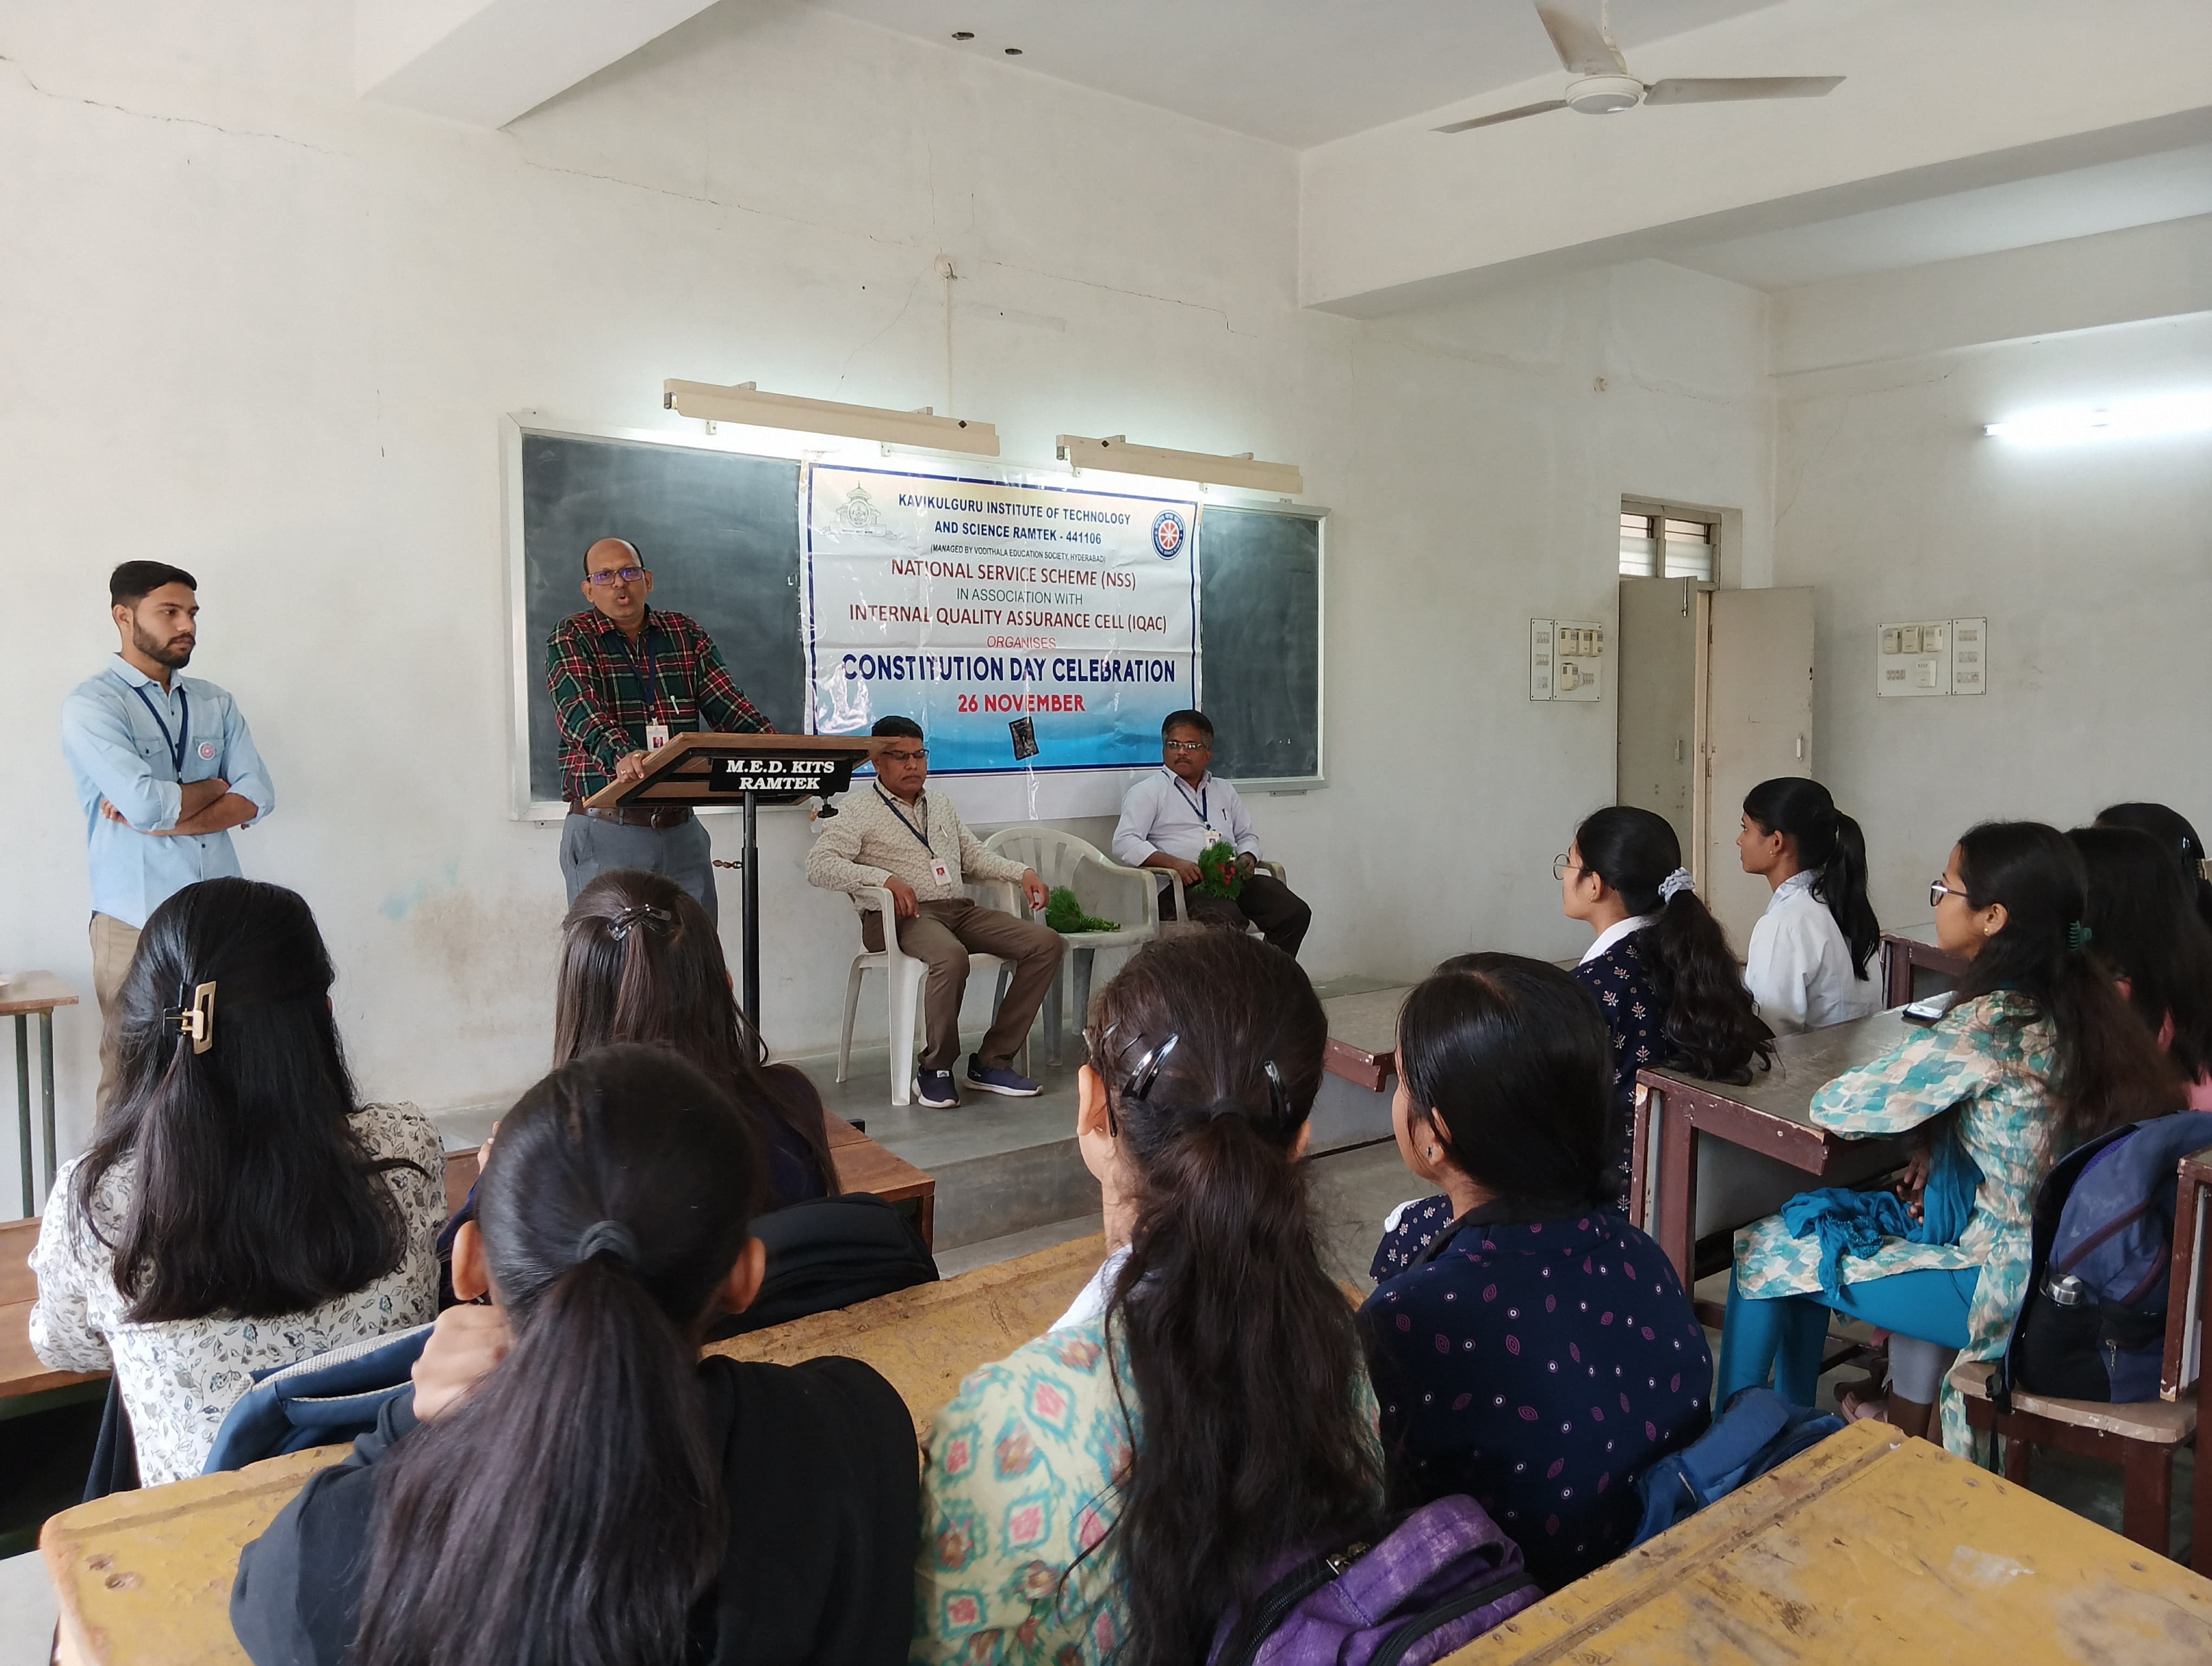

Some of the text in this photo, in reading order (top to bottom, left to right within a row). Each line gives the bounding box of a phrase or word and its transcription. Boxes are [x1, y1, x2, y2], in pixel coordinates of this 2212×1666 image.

[899, 494, 1131, 525] KAVIKULGURU INSTITUTE OF TECHNOLOGY
[935, 521, 958, 534] AND
[962, 523, 1009, 537] SCIENCE
[1013, 527, 1057, 541] RAMTEK
[1066, 531, 1101, 544] 441106
[930, 544, 963, 555] (MANAGED
[974, 547, 1008, 556] VODITHALA
[1009, 549, 1043, 559] EDUCATION
[1045, 552, 1070, 561] SOCIETY,
[1070, 554, 1106, 564] HYDERABAD)
[892, 559, 1136, 591] NATIONAL SERVICE SCHEME (NSS)
[957, 588, 1083, 605] IN ASSOCIATION WITH
[850, 604, 1167, 634] INTERNAL QUALITY ASSURANCE CELL (IQAC)
[987, 636, 1056, 649] ORGANISES
[842, 653, 1175, 682] CONSTITUTION DAY CELEBRATION
[958, 694, 1086, 712] 26 NOVEMBER
[726, 760, 835, 773] M.E.D. KITS
[738, 777, 821, 790] RAMTEK
